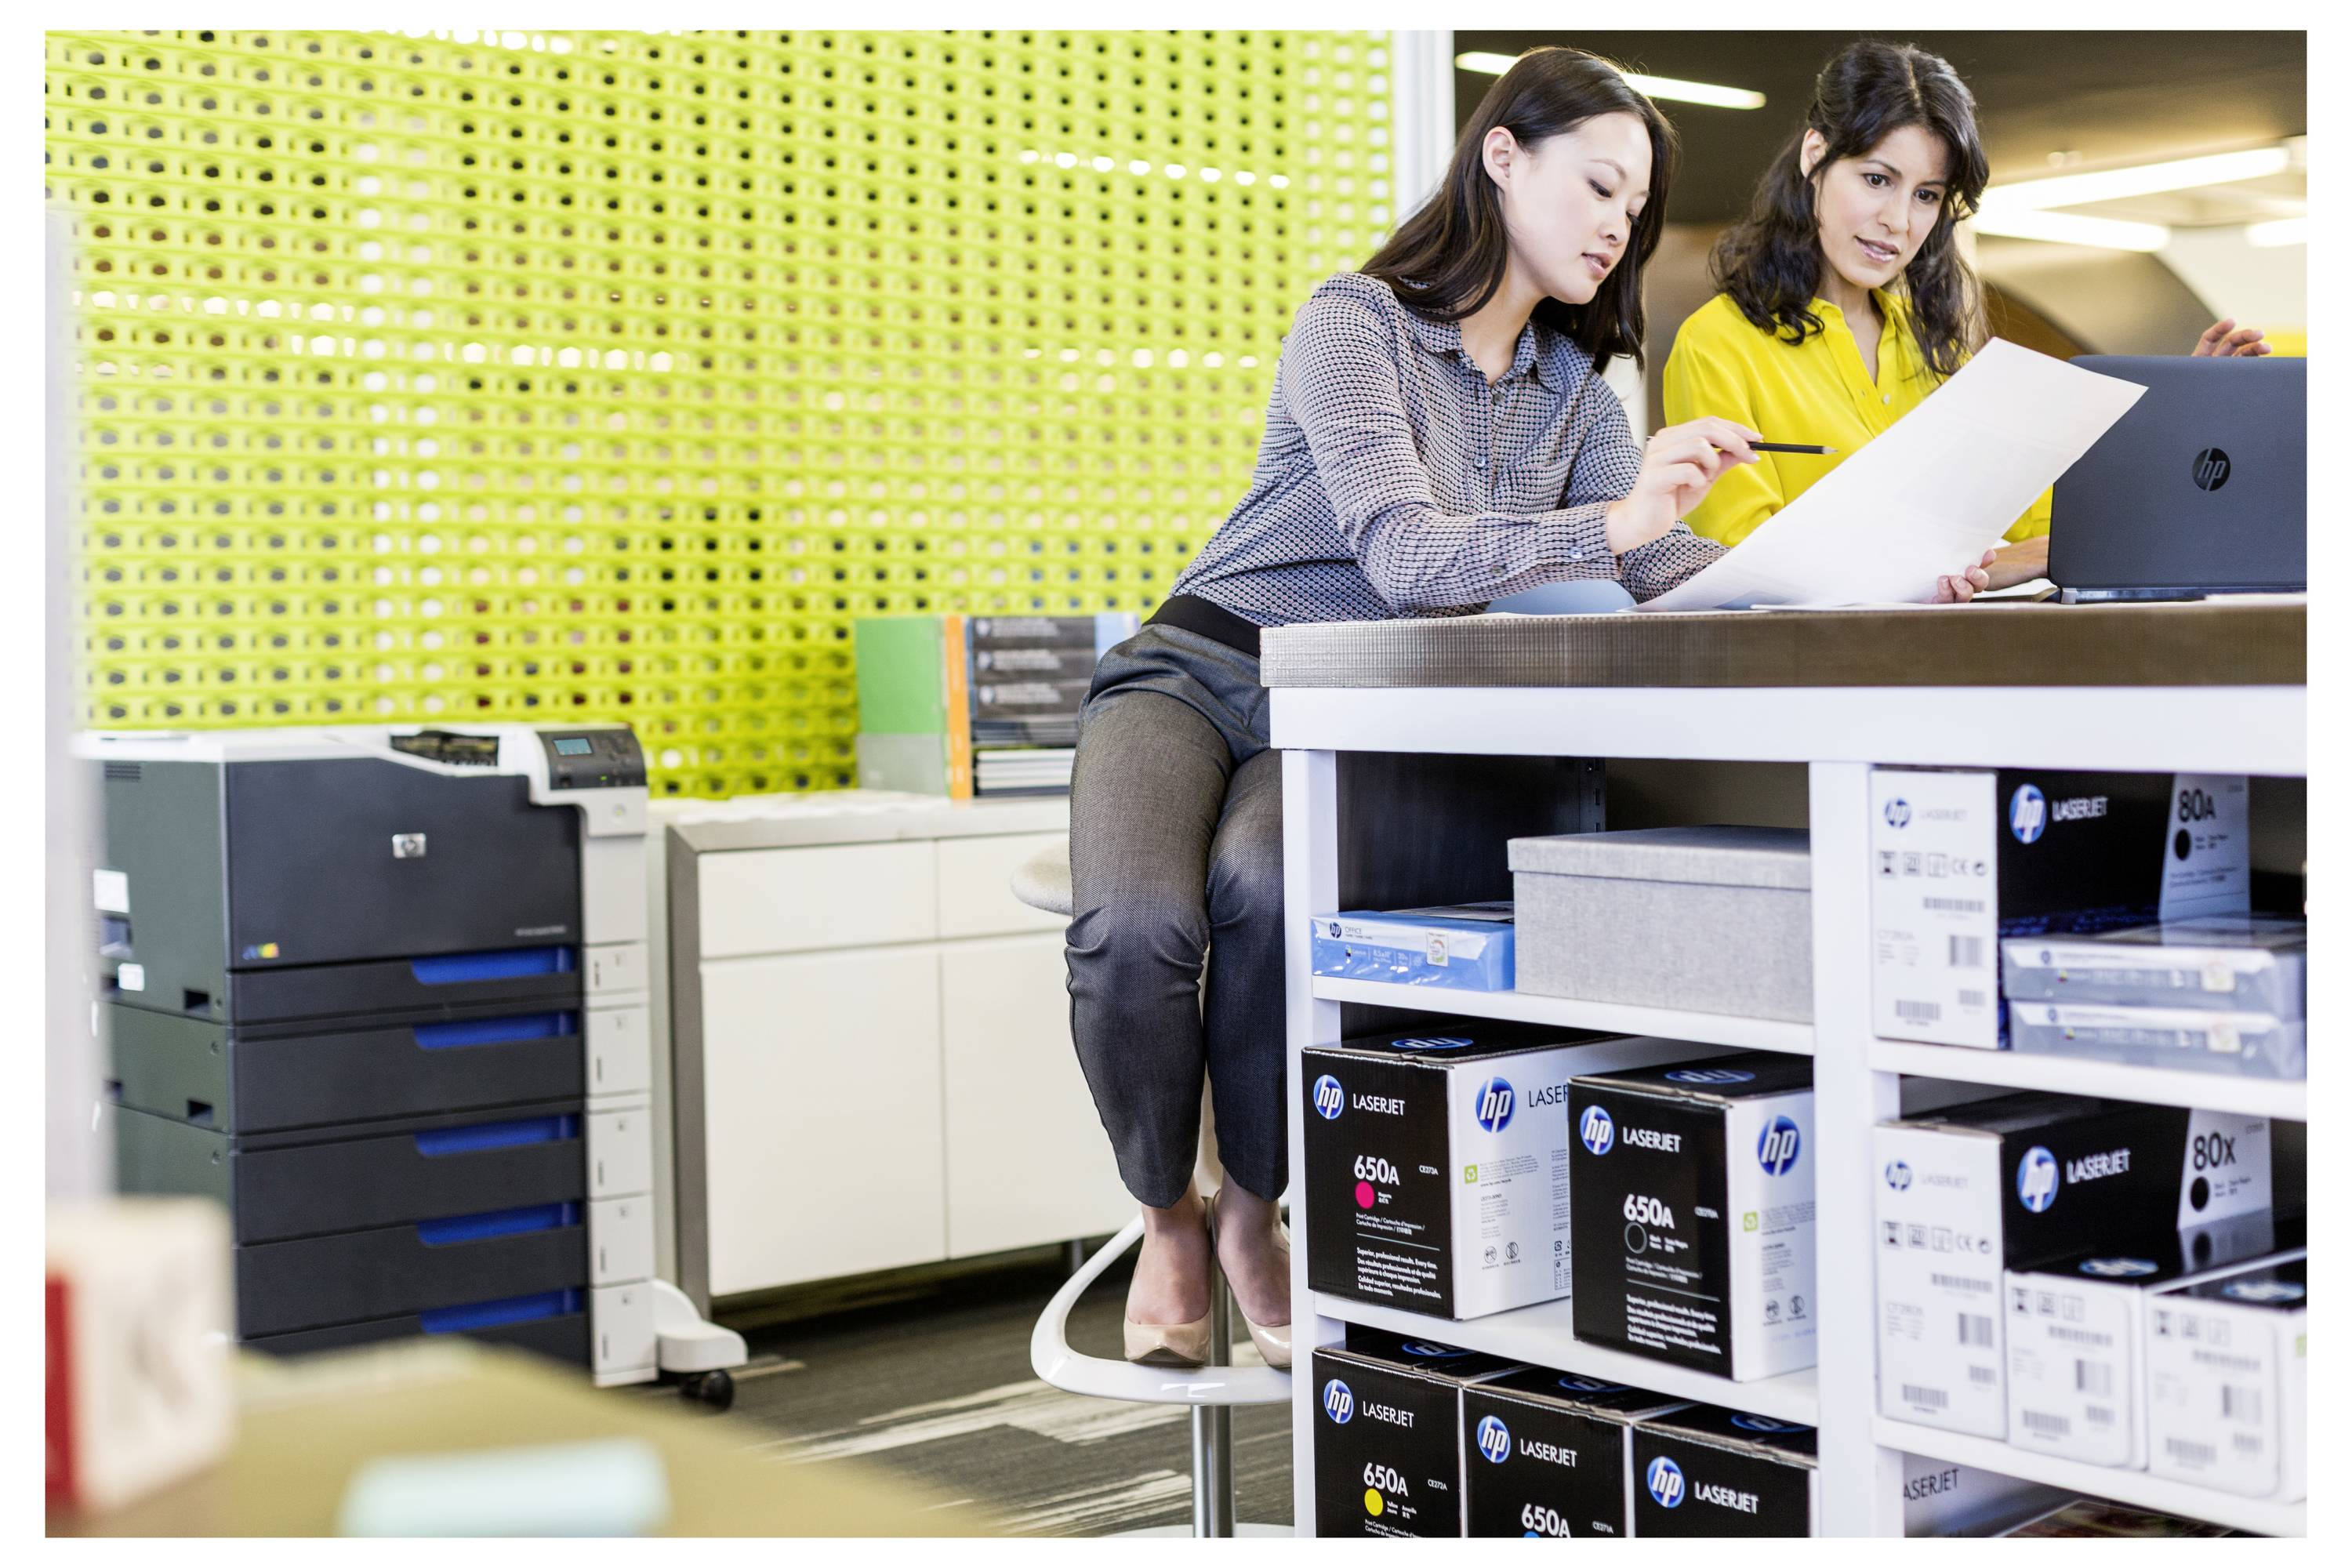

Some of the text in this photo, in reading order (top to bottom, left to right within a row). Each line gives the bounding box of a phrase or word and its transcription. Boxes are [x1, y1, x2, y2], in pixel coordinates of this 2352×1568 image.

[2192, 448, 2230, 492] hp
[2009, 784, 2108, 844] hp LASERJET
[2178, 789, 2216, 822] 80A
[1330, 922, 1341, 938] hp
[1314, 1075, 1405, 1120] hp LASERJET
[1477, 1077, 1515, 1133] hp
[1580, 1105, 1681, 1155] hp LASERJET
[1759, 1115, 1800, 1177] hp
[1354, 1155, 1399, 1185] 650A
[2066, 1148, 2130, 1184] LASERJET
[1624, 1193, 1675, 1229] 650A
[1323, 1379, 1414, 1428] hp LASERJET
[1478, 1415, 1577, 1468] hp LASERJET
[1363, 1462, 1408, 1497] 650A
[1428, 1479, 1447, 1491] CE272A
[1648, 1456, 1759, 1515] hp LASERJET
[1521, 1503, 1571, 1537] 650A
